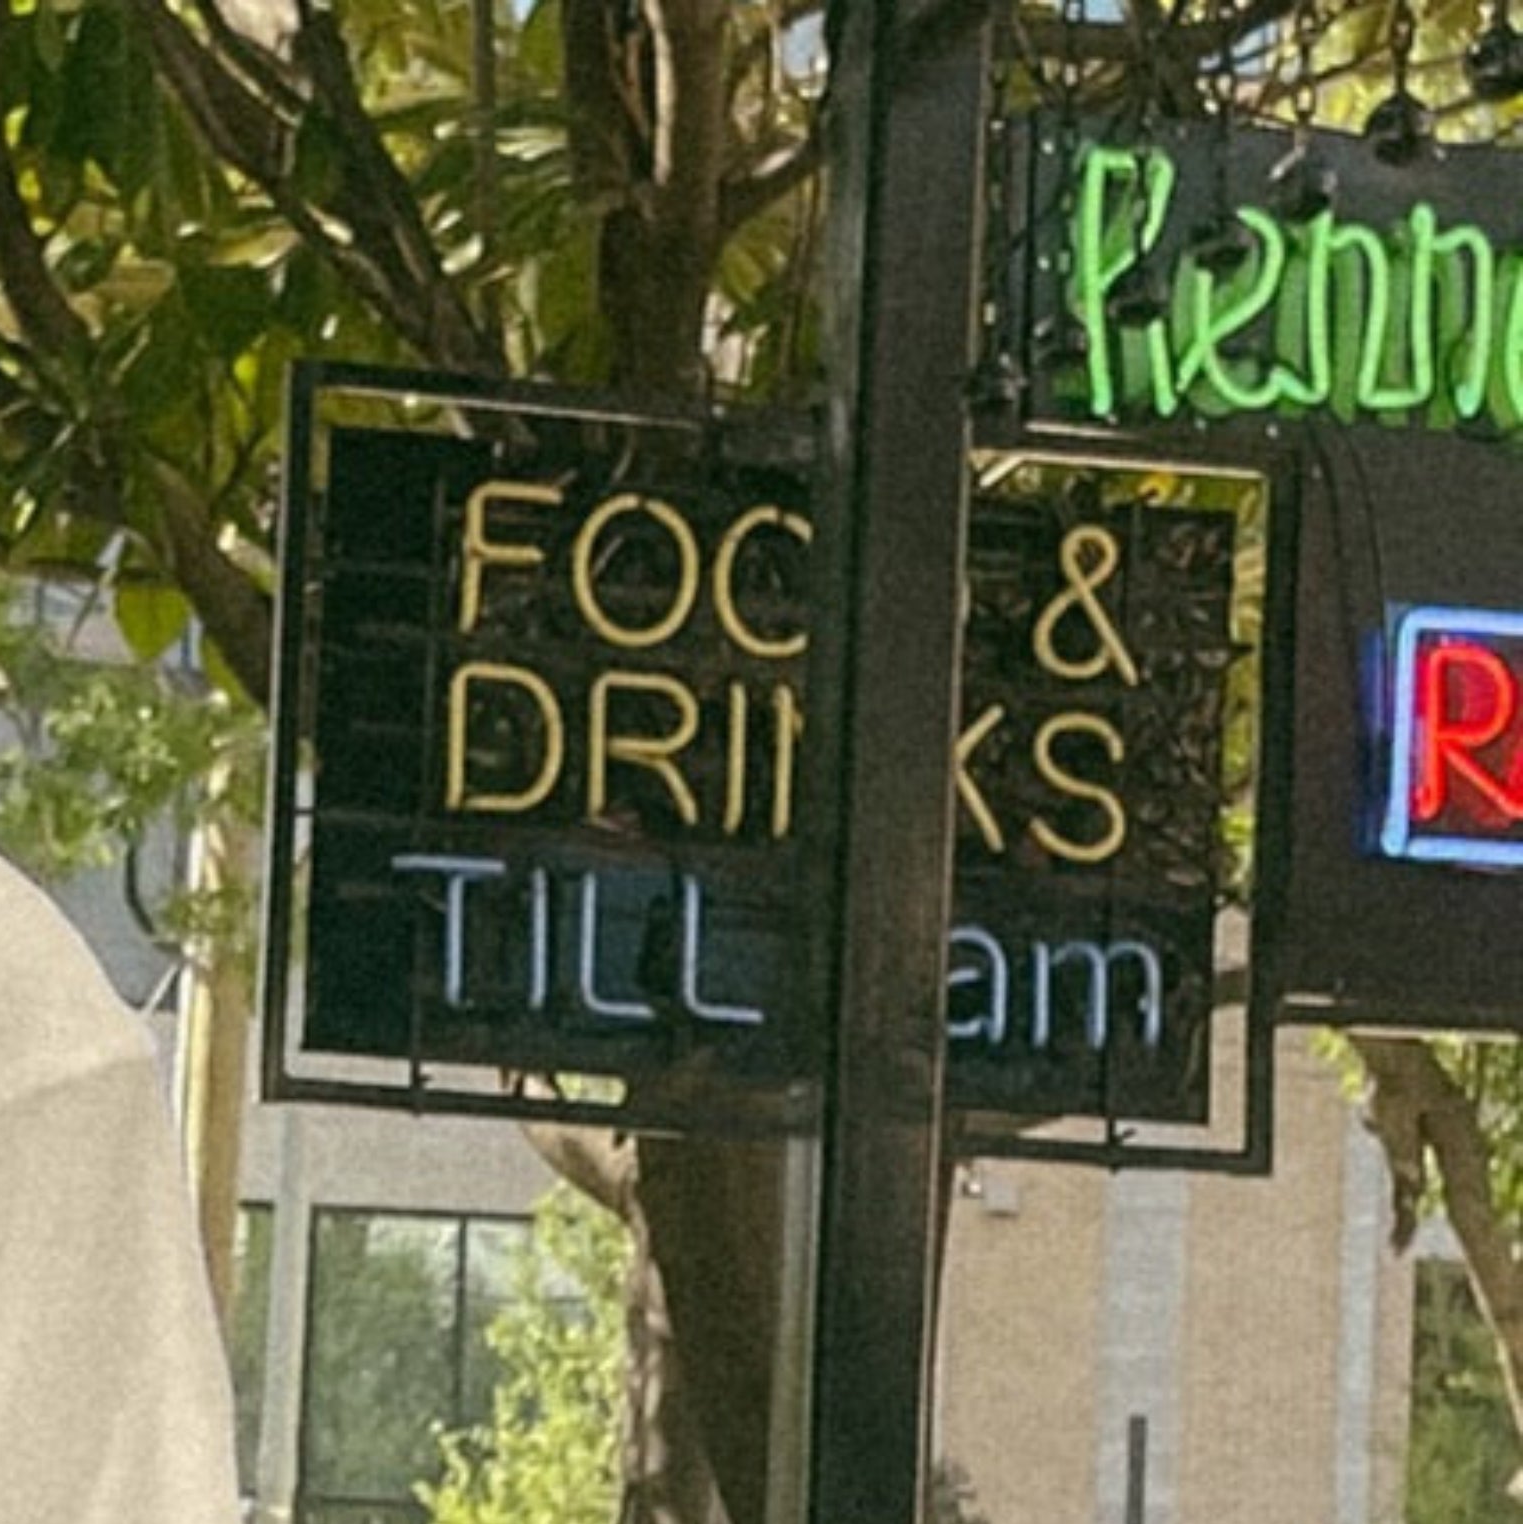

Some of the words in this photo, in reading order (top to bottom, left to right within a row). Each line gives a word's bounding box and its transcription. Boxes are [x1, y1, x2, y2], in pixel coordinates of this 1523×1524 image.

[459, 478, 815, 660] FOO
[1032, 524, 1141, 687] &
[391, 852, 765, 1024] TILL
